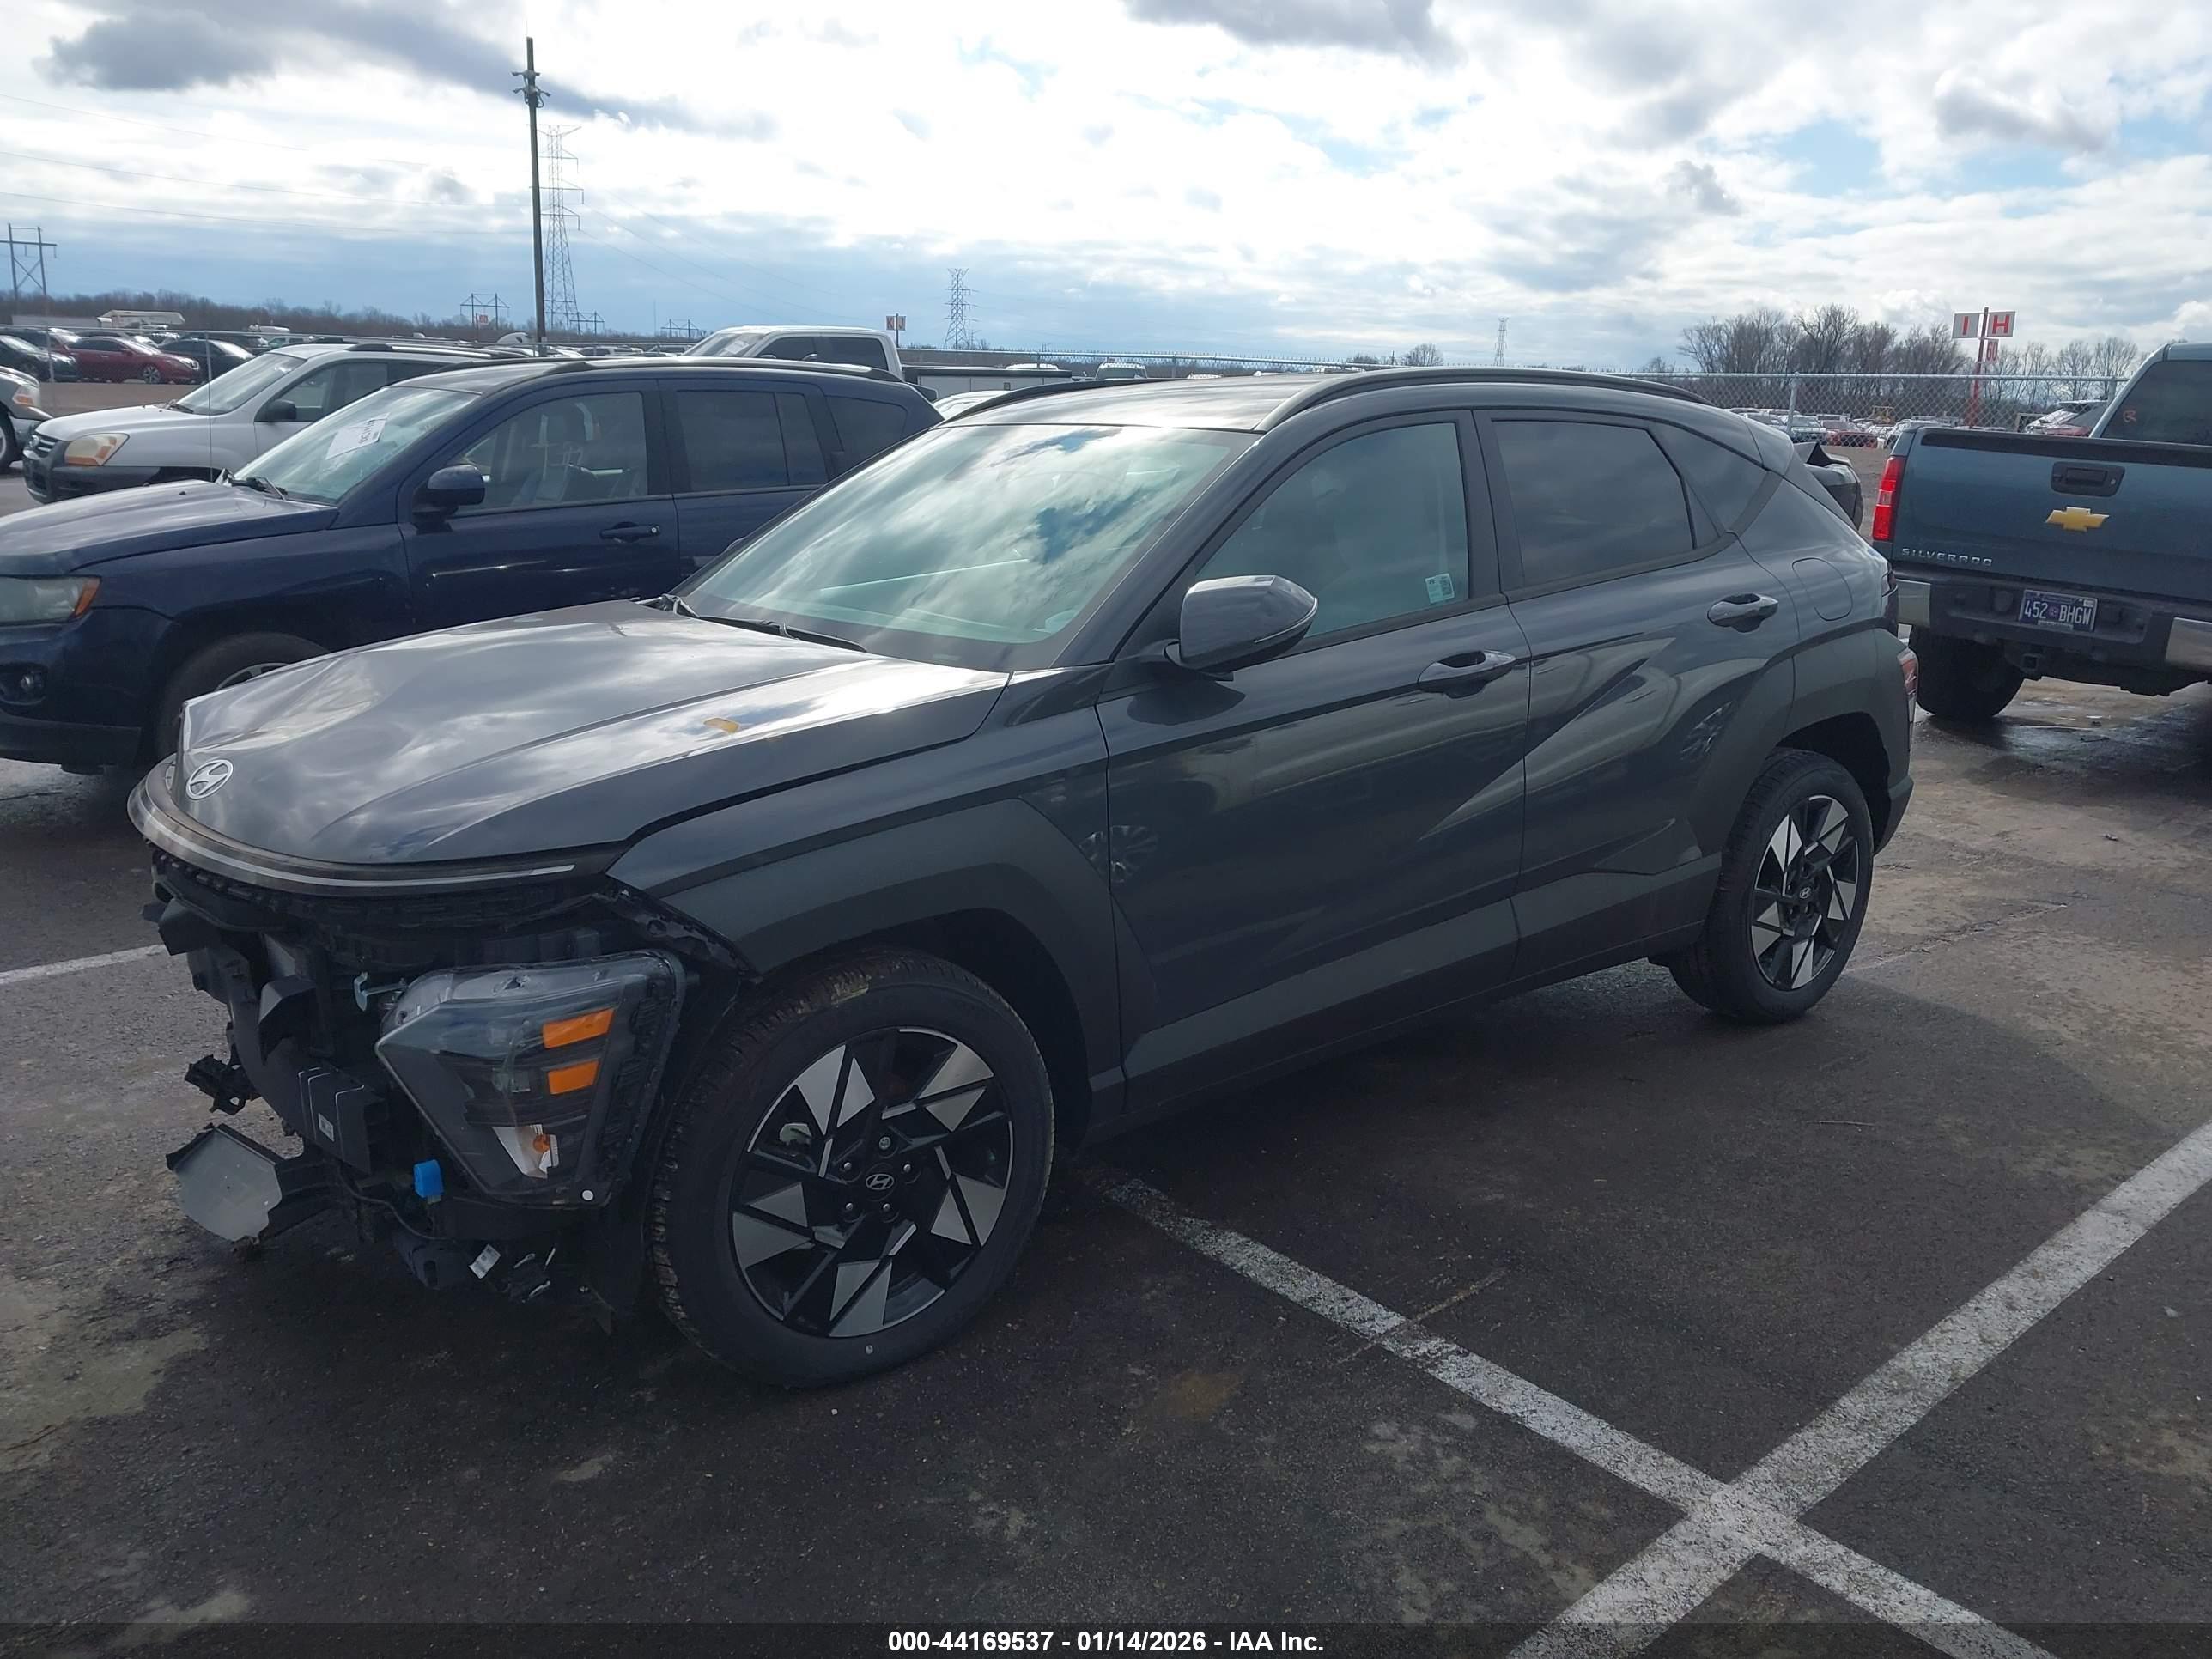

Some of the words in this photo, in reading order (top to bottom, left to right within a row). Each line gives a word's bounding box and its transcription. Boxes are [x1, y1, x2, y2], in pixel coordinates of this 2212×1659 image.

[886, 317, 893, 330] K
[1992, 314, 2010, 334] H
[1986, 341, 1999, 361] 60
[1901, 548, 1992, 566] SILVERADO
[2024, 600, 2049, 619] 452
[2058, 605, 2092, 625] BHGW
